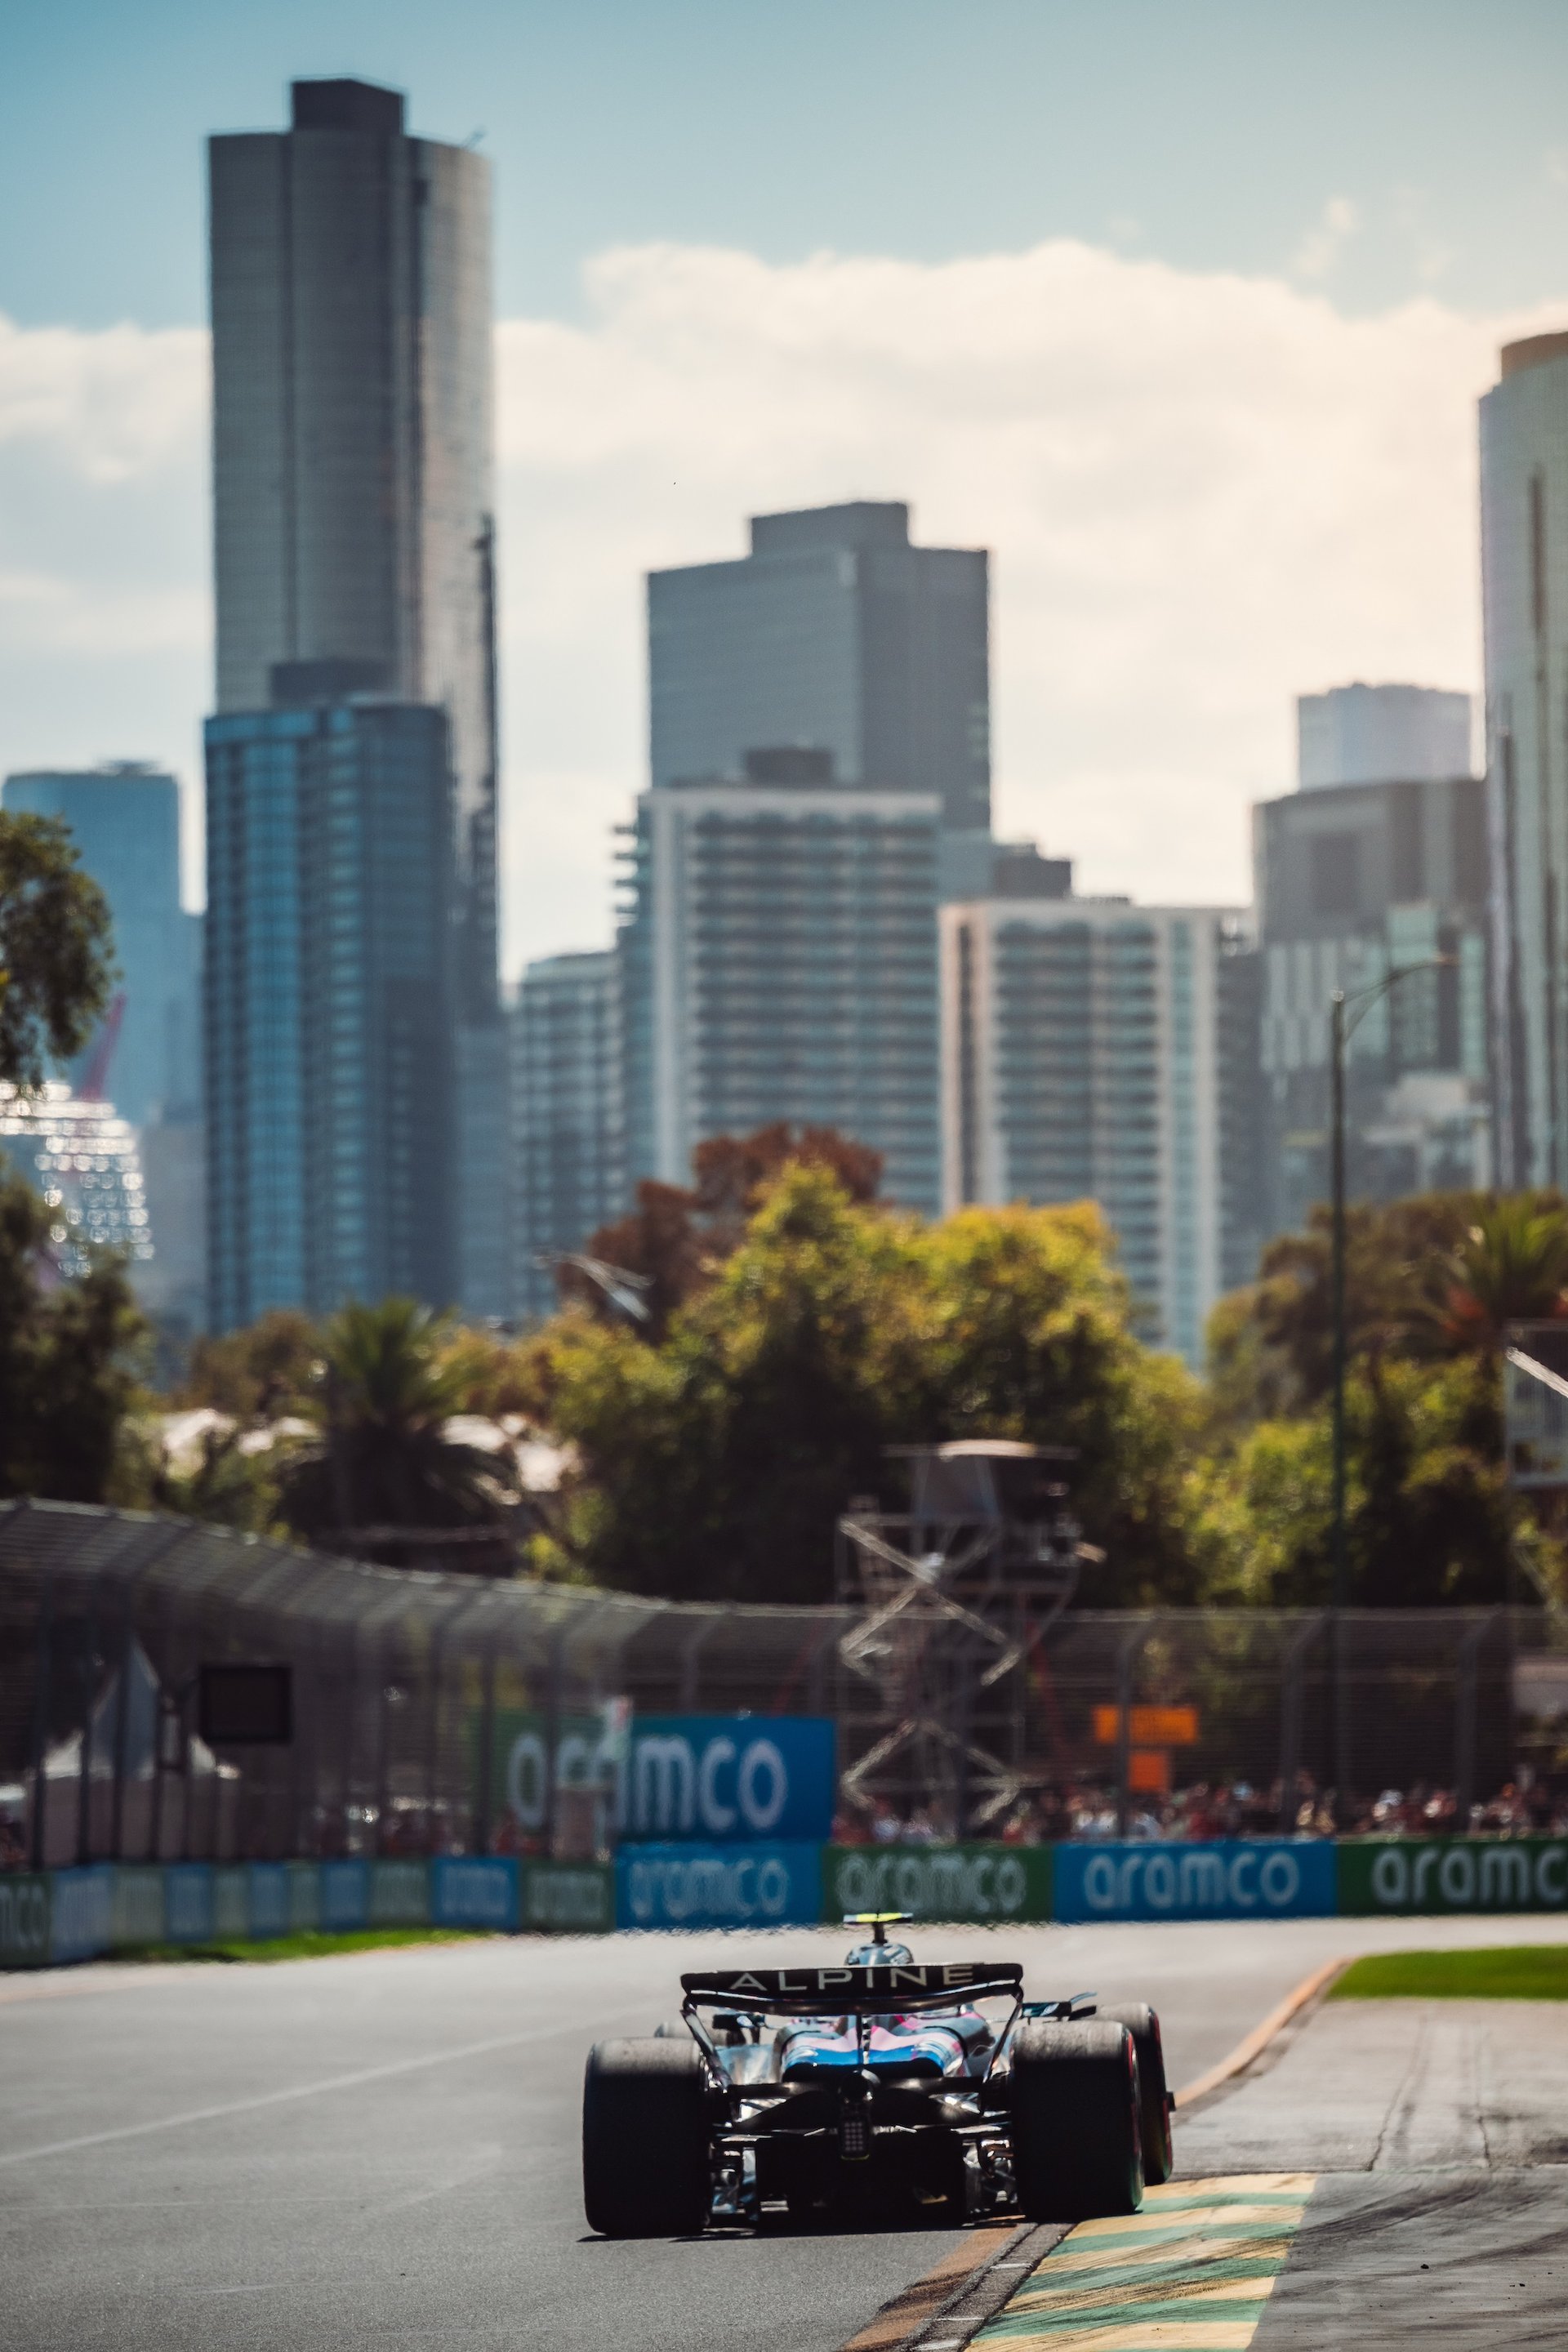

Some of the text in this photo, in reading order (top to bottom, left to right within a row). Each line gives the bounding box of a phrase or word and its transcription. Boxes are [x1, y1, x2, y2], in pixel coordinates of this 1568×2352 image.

[835, 1852, 1027, 1913] aramco
[1083, 1850, 1301, 1909] aramco
[729, 1964, 974, 1992] ALPINE
